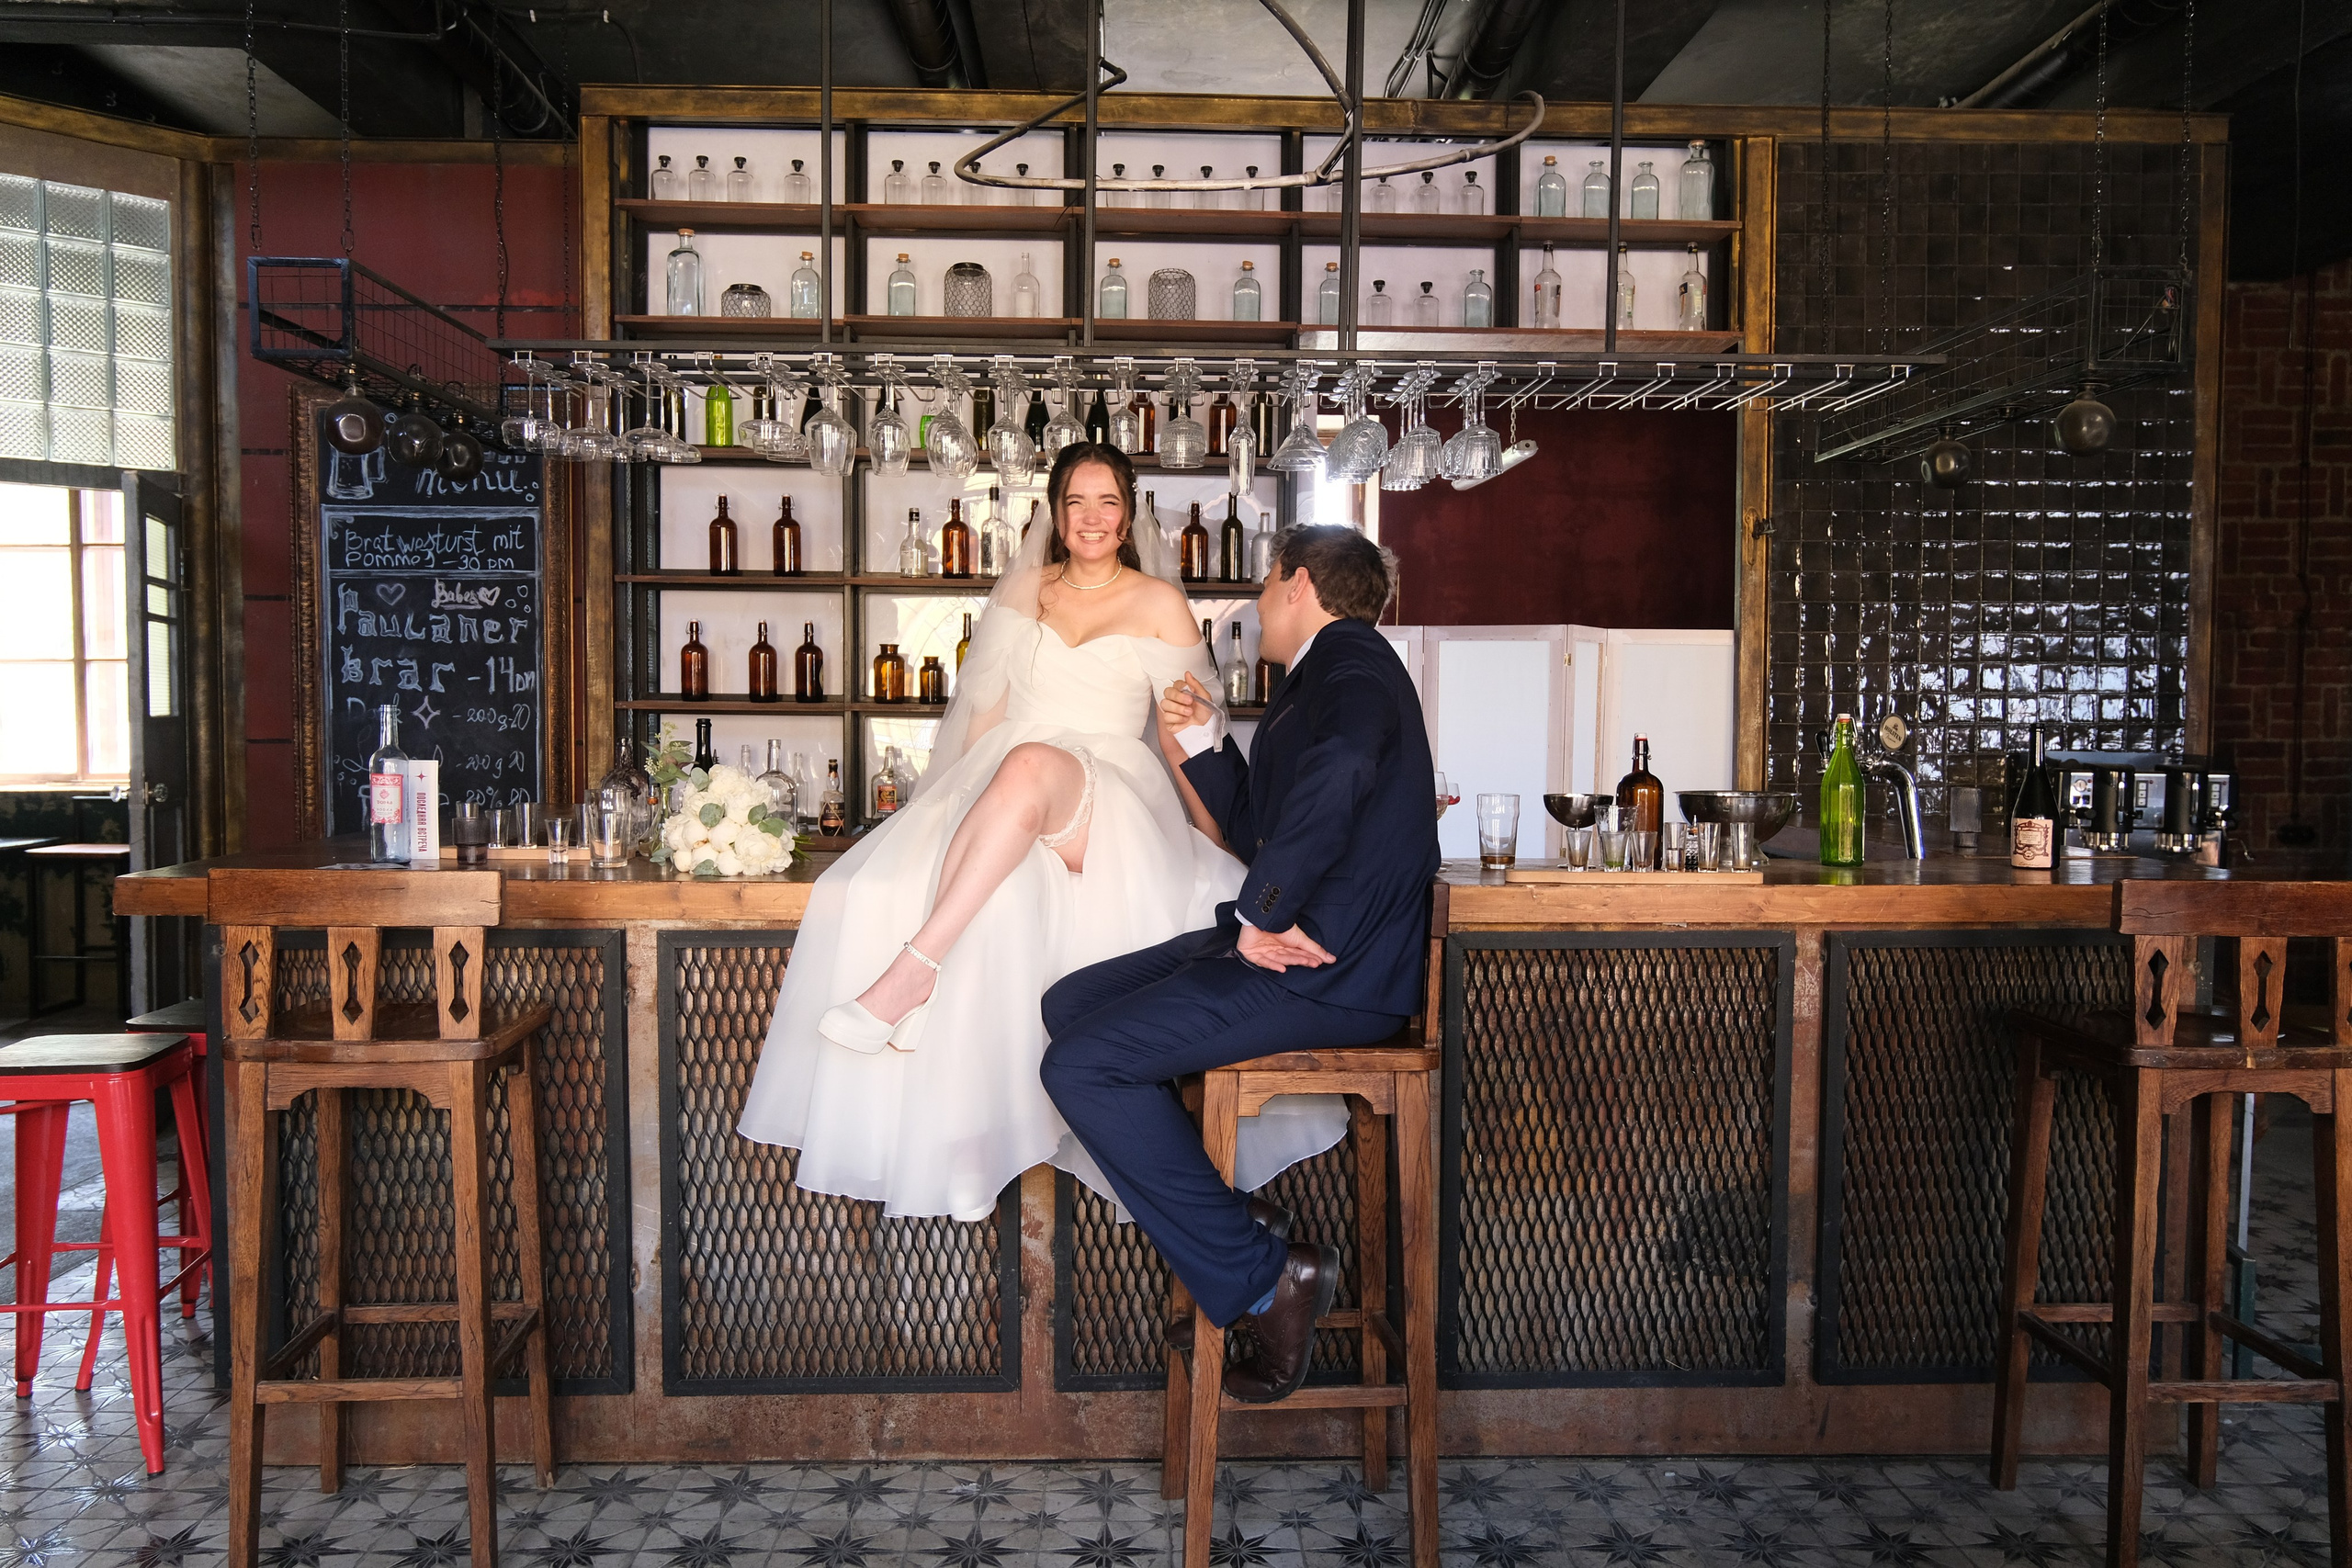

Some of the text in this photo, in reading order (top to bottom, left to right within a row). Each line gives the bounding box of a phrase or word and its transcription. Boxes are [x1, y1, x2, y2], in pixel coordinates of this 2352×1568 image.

[493, 524, 525, 552] mit
[416, 792, 428, 852] ПОСЛЕДНЯЯ ВСТРЕЧА
